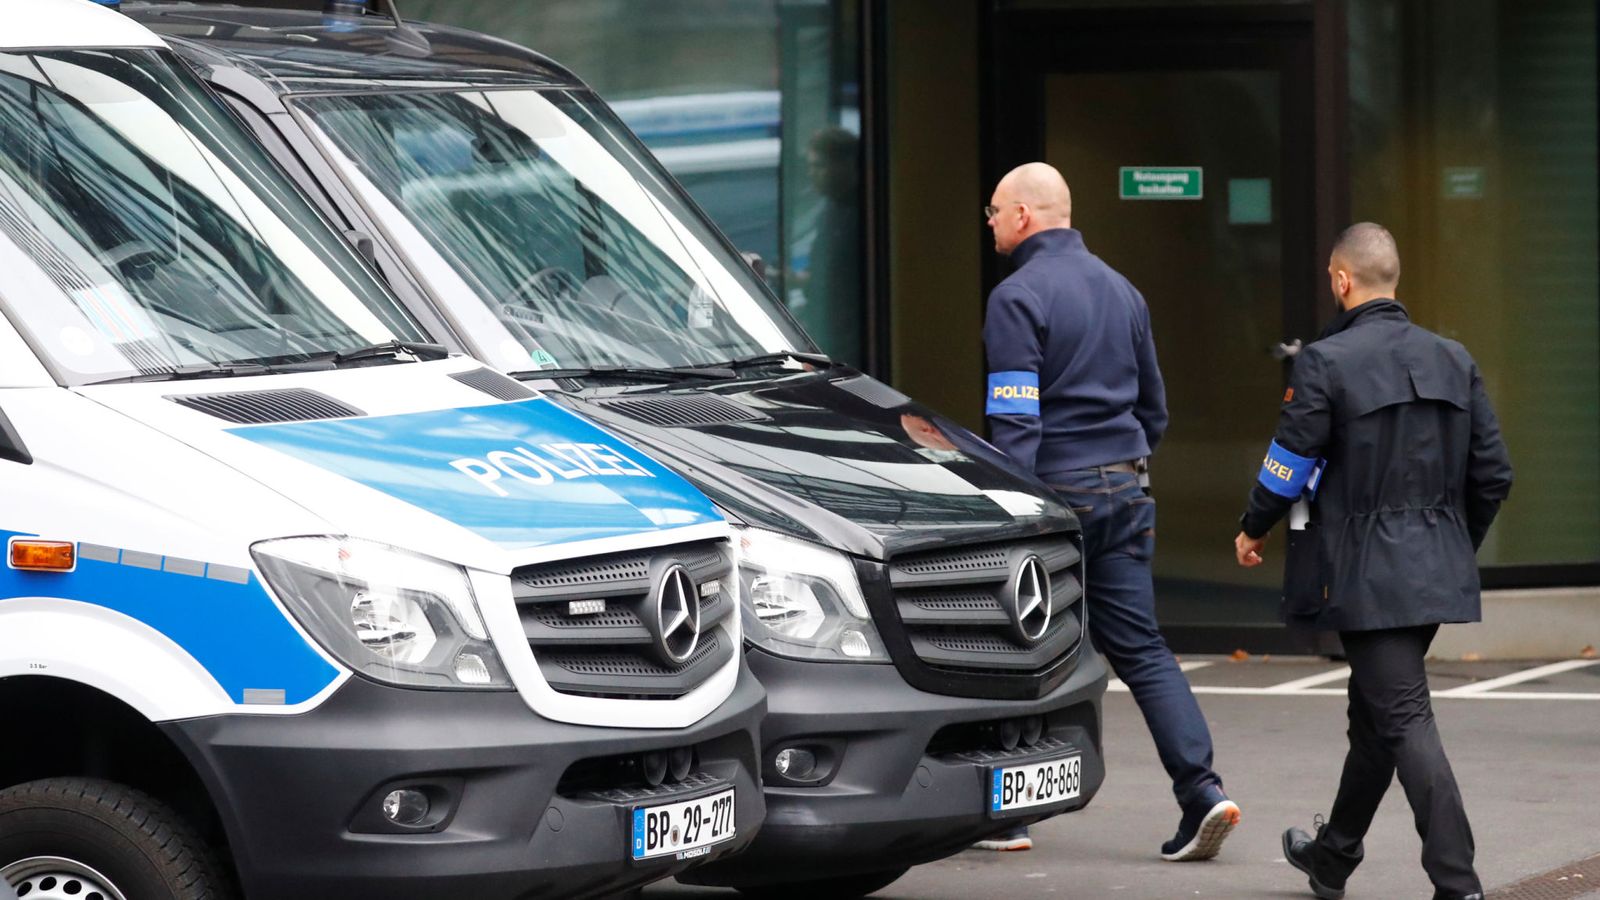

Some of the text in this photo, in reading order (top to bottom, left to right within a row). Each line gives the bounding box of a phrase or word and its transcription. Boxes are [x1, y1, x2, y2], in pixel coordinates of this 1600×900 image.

[448, 443, 657, 497] POLIZEI
[1003, 760, 1080, 805] BP 28-868
[647, 796, 732, 850] BP 29-277
